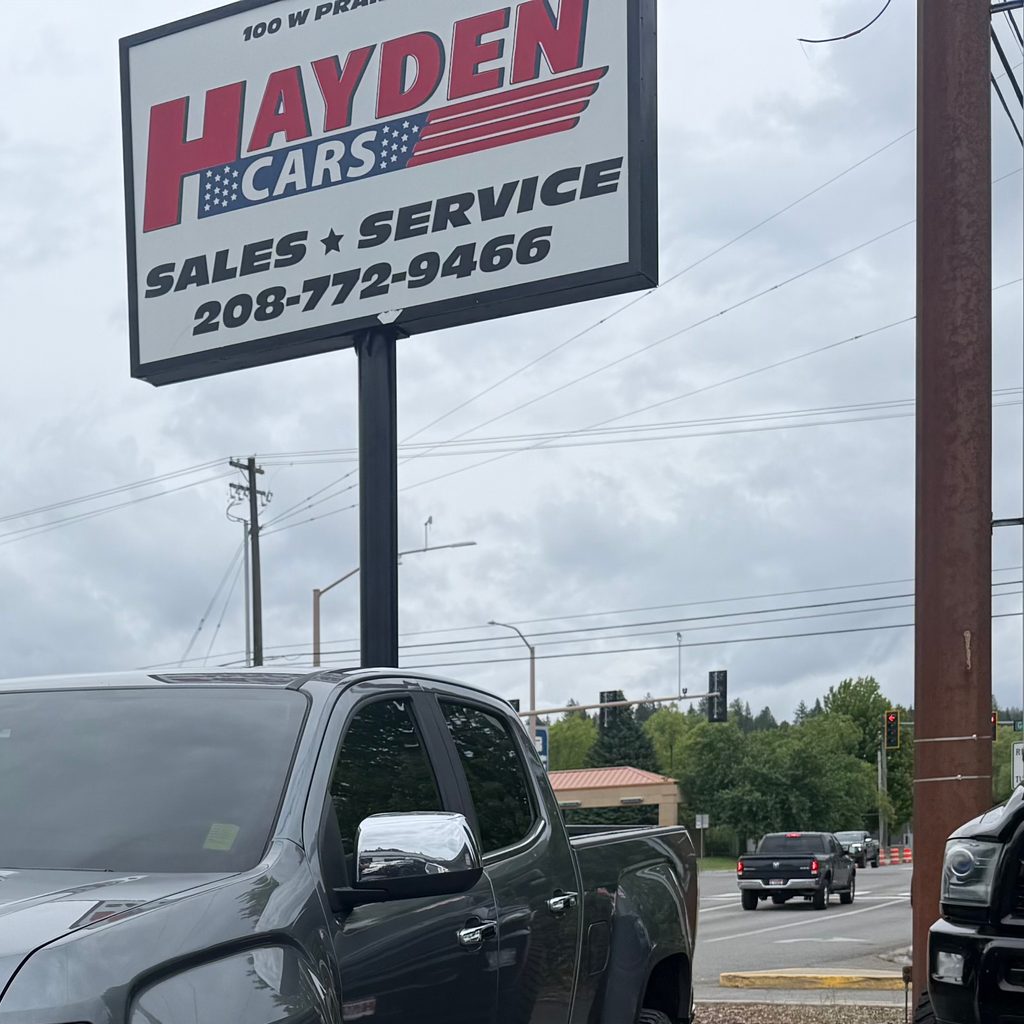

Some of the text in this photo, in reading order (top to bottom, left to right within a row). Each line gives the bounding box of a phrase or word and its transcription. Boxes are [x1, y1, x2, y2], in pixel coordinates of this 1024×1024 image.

[243, 17, 282, 41] 100
[288, 9, 310, 28] W
[143, 0, 590, 233] HAYDEN
[241, 130, 376, 203] CARS
[144, 156, 624, 298] SALES SERVICE
[192, 225, 553, 336] 208-772-9466
